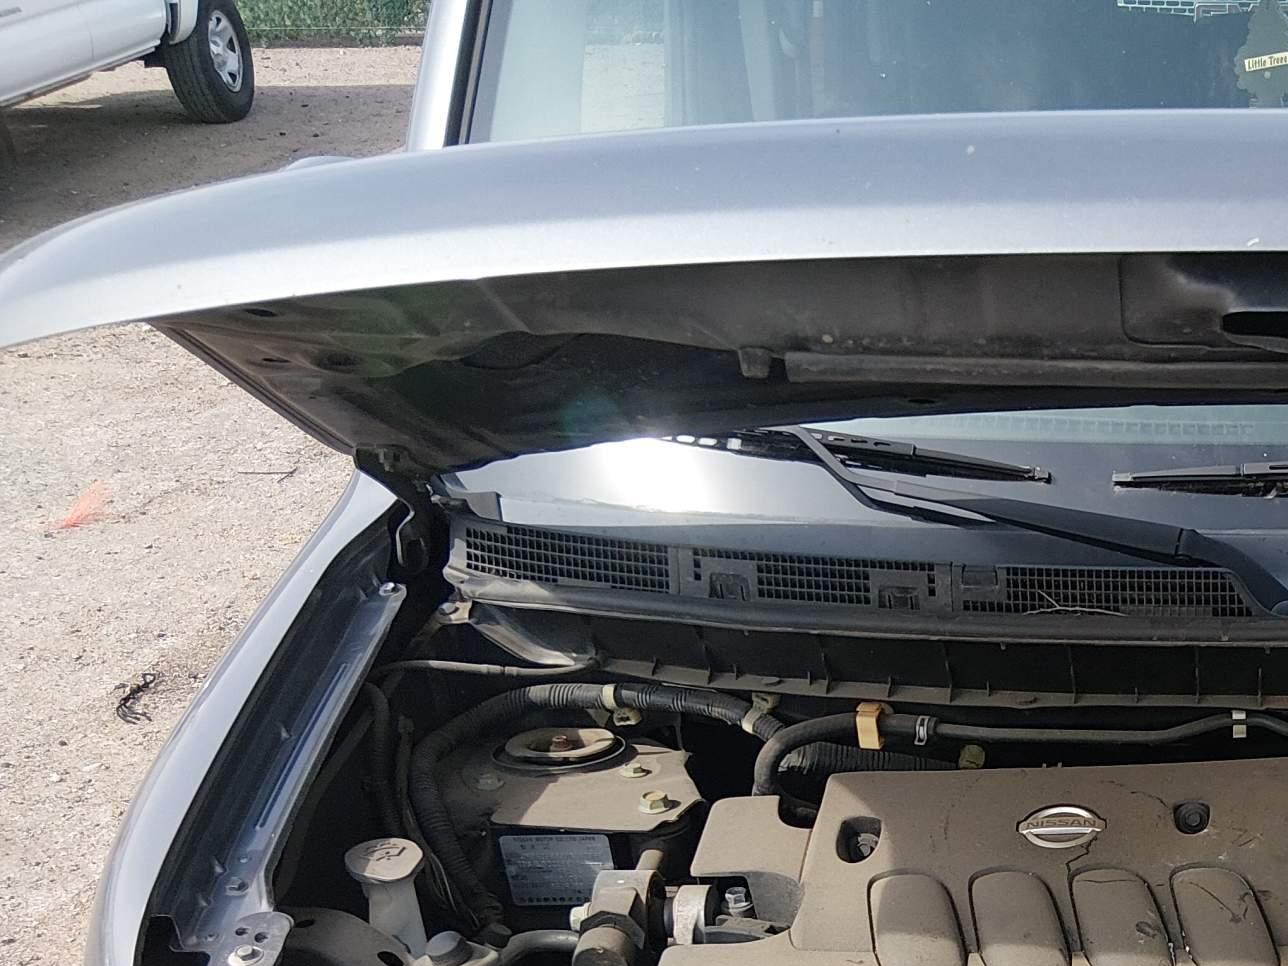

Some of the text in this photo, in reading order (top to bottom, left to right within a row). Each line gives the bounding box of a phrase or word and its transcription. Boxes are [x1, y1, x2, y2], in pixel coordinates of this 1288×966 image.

[1247, 55, 1288, 70] Little Trees
[1026, 818, 1096, 829] NISSAN
